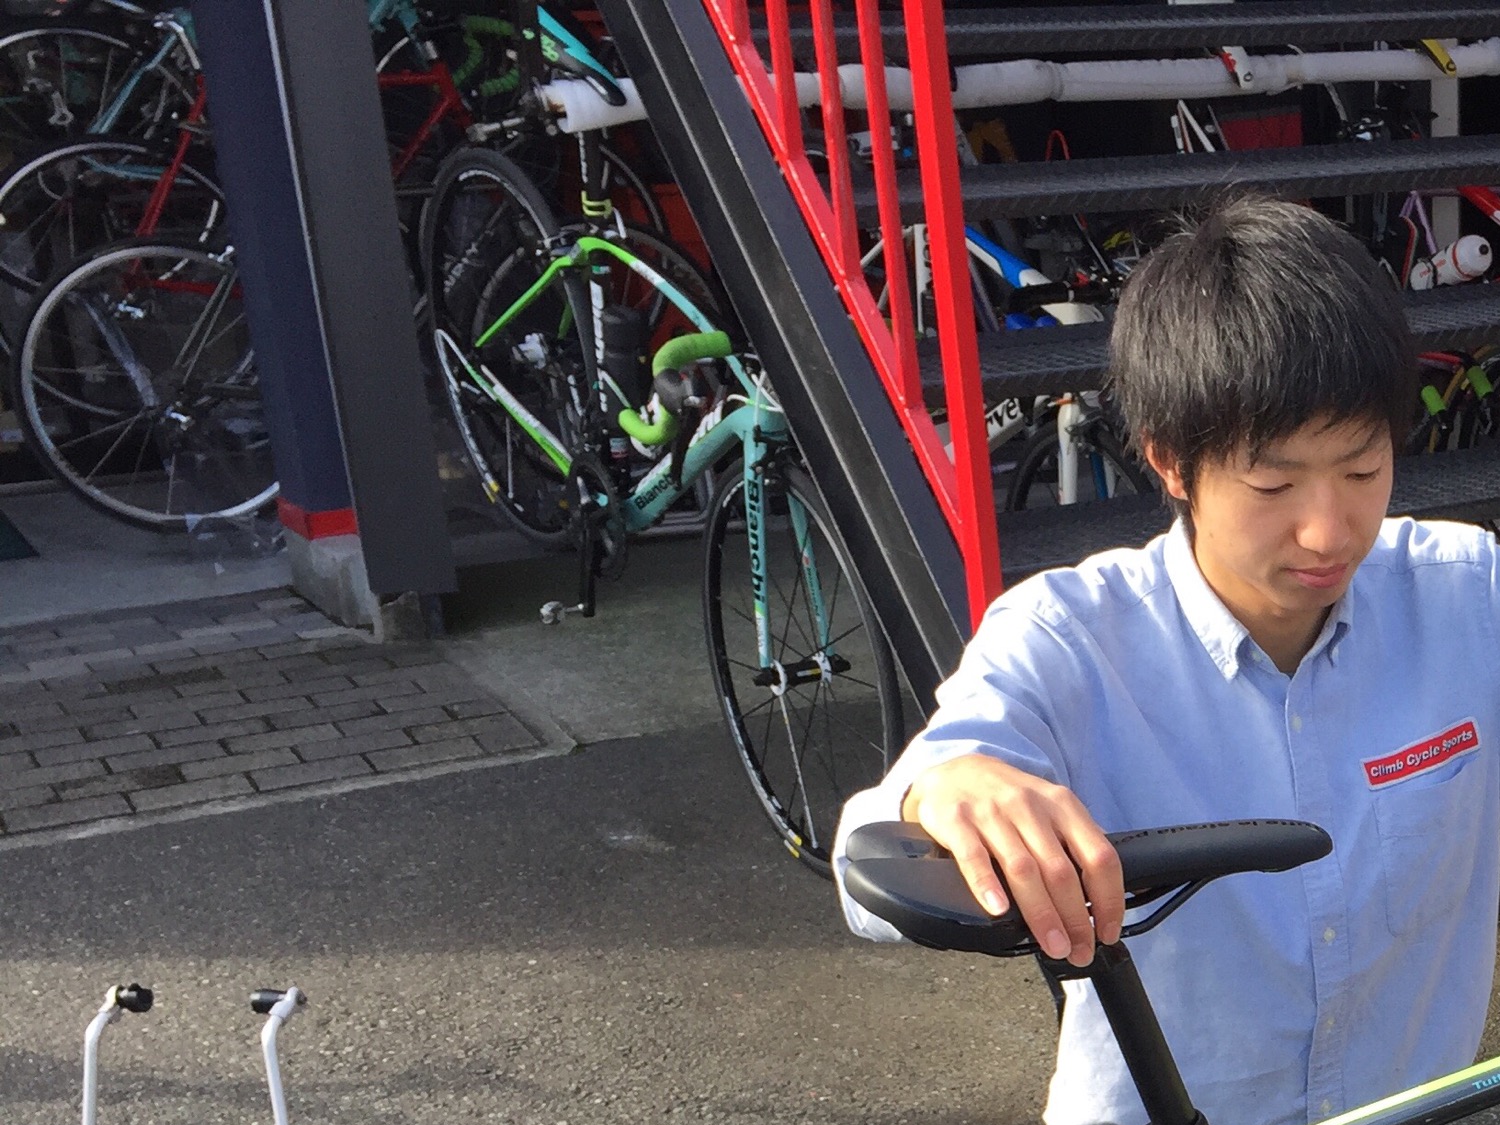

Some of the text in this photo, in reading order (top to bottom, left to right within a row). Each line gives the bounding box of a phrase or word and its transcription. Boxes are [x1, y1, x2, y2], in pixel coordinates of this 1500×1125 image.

[634, 470, 682, 510] Bianch
[748, 479, 765, 602] Bianchi
[1370, 730, 1473, 777] Climb Cycle Sports
